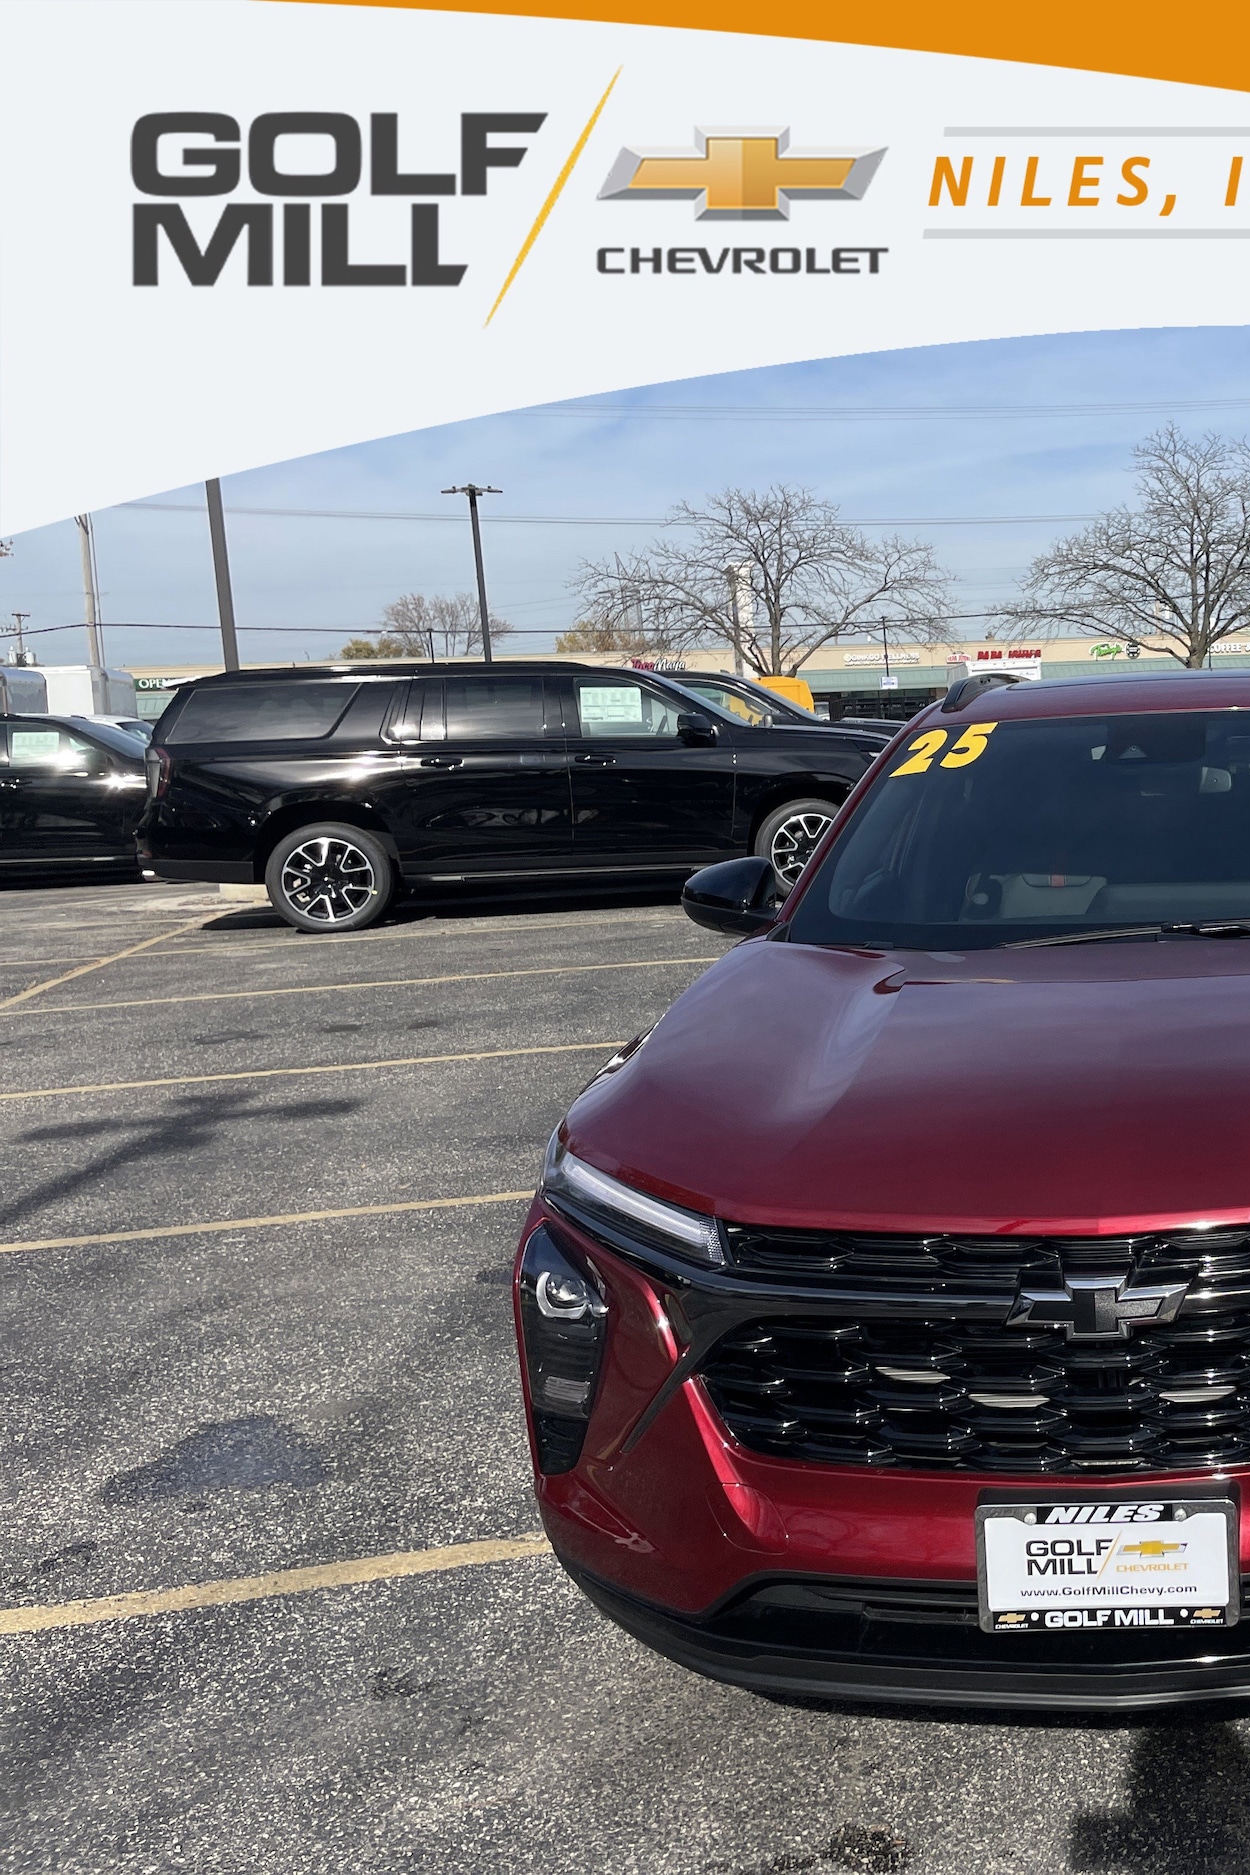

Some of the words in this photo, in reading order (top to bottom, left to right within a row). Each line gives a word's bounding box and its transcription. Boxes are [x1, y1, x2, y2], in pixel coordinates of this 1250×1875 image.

[888, 721, 999, 778] 25
[1044, 1504, 1165, 1525] NILES
[1025, 1539, 1114, 1557] GOLF
[1027, 1558, 1099, 1576] MILL
[1116, 1562, 1189, 1573] CHEVROLET
[1020, 1584, 1198, 1597] www.GolfMillChevy.com
[1044, 1610, 1112, 1627] GOLF
[1115, 1609, 1175, 1626] MILL
